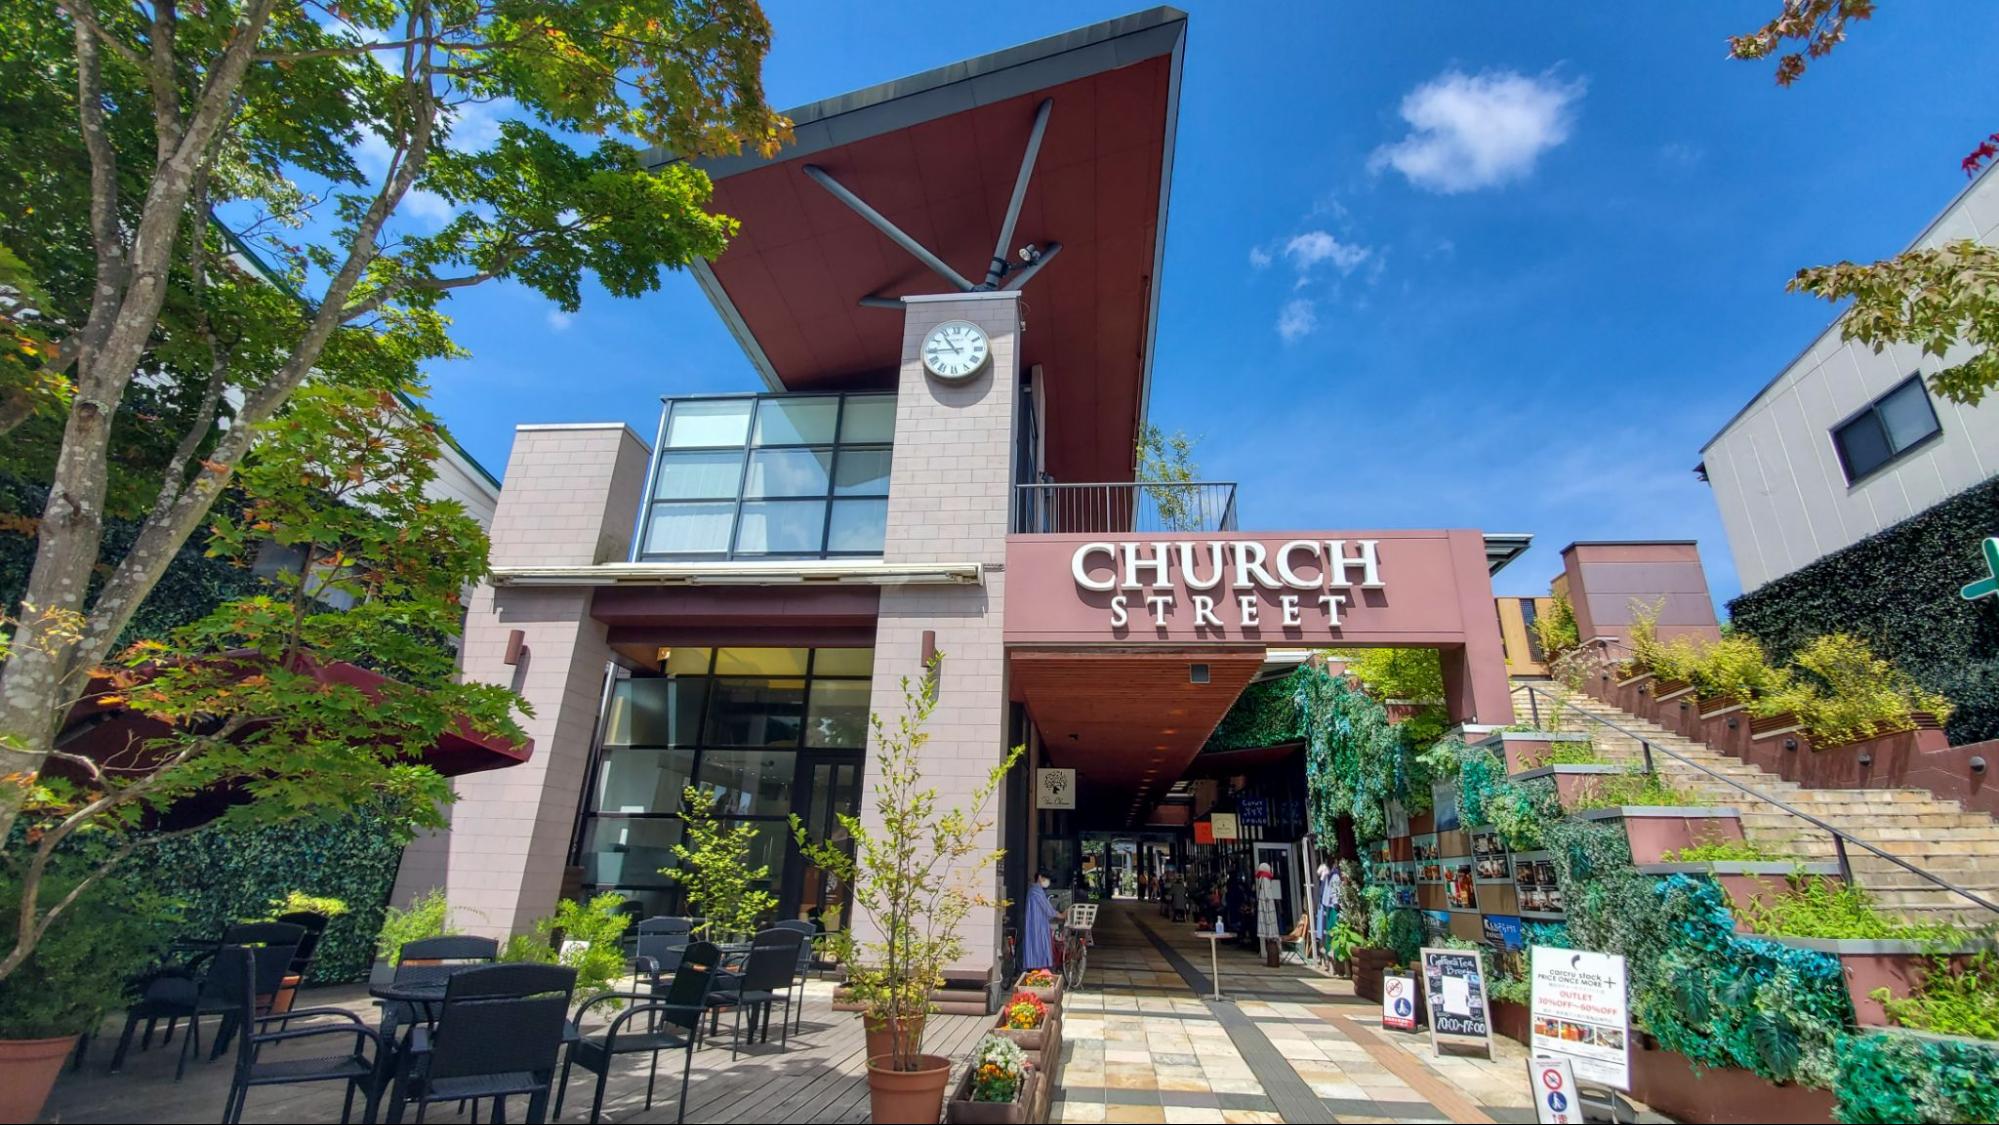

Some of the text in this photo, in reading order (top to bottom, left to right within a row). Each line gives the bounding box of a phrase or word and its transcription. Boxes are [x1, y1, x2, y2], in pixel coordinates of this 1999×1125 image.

[1071, 540, 1386, 591] CHURCH
[1110, 595, 1346, 627] STREET
[1538, 973, 1556, 981] PRICE
[1558, 975, 1579, 985] ONCE
[1581, 980, 1602, 988] MORE
[1579, 972, 1602, 982] stock
[1559, 990, 1592, 1001] OUTLET
